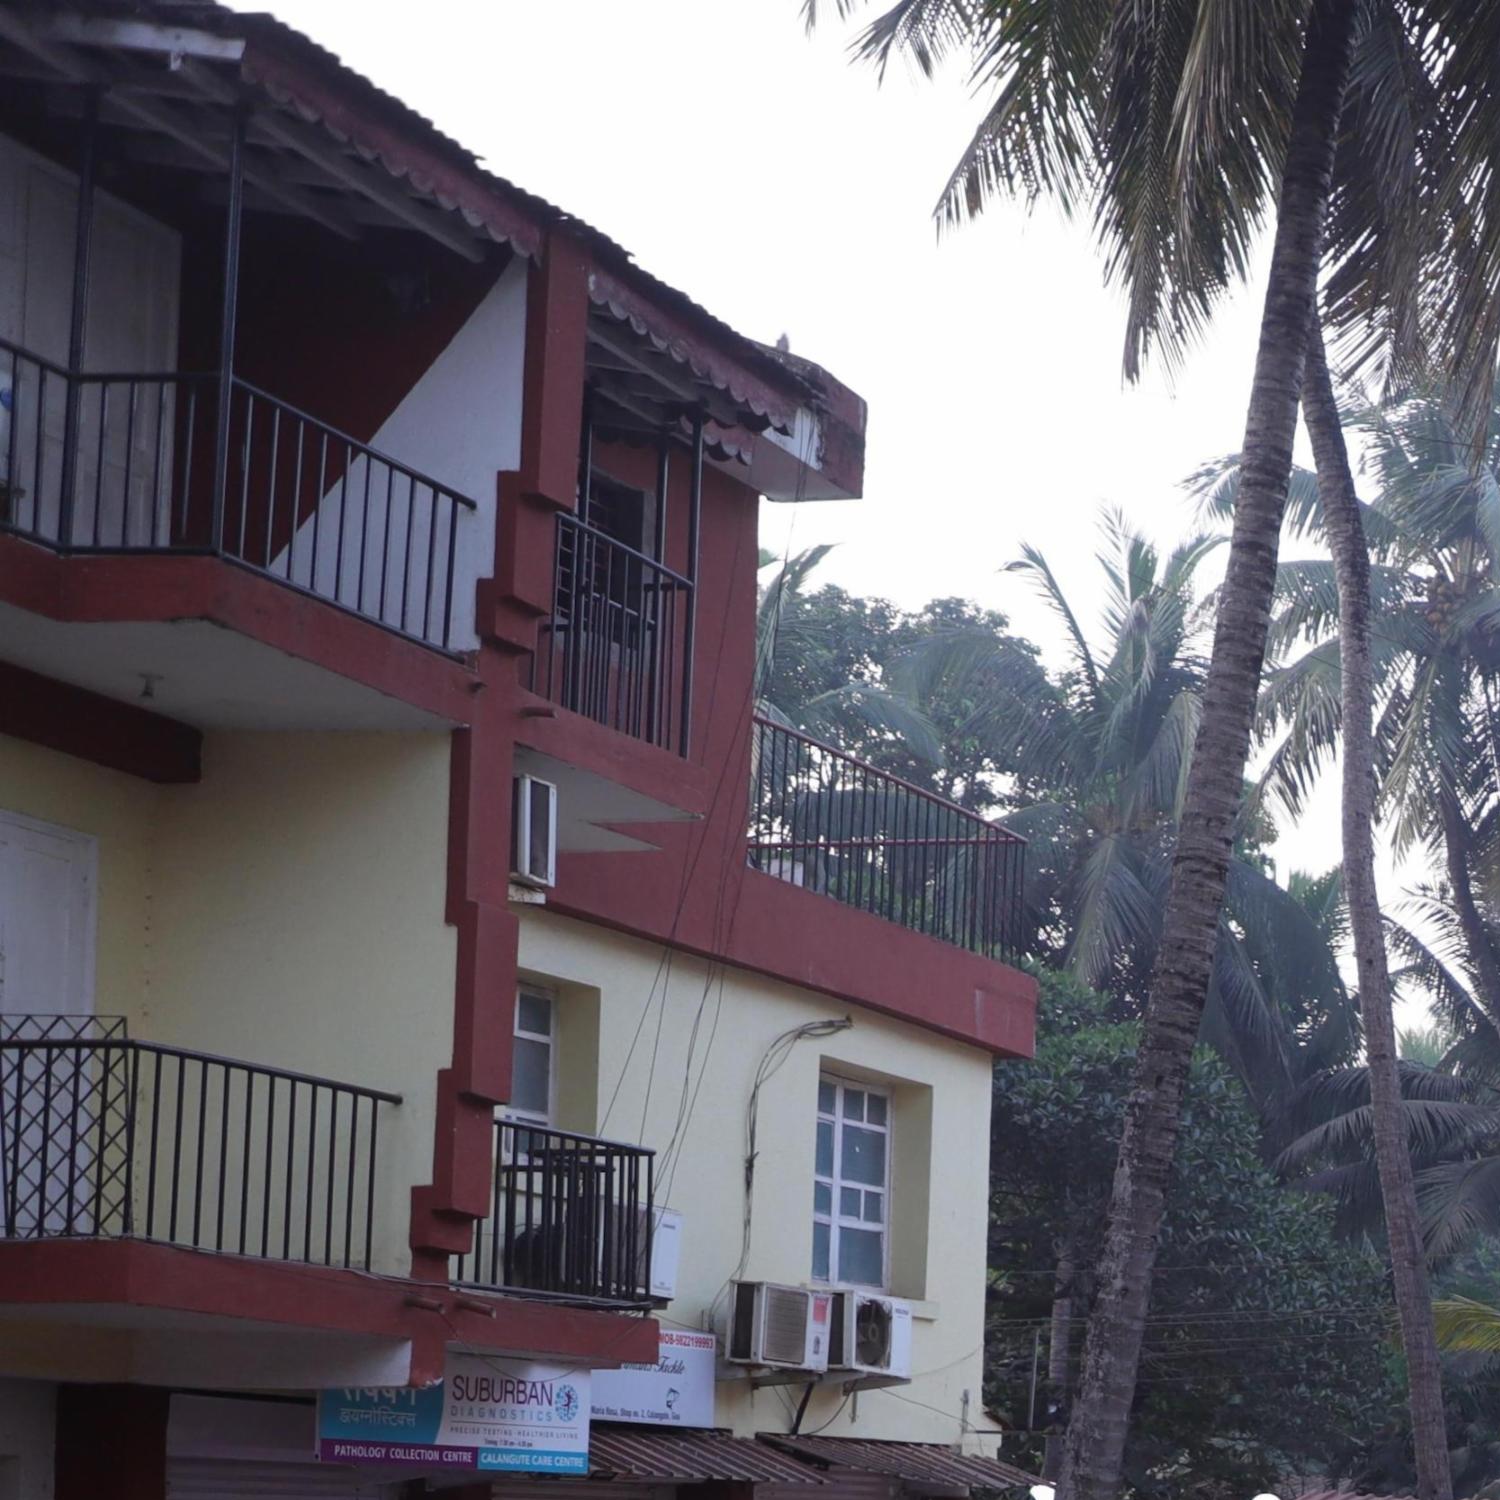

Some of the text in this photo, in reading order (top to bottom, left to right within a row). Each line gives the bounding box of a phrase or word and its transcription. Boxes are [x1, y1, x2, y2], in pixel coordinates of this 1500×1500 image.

[452, 1375, 553, 1407] SUBURBAN
[450, 1405, 553, 1421] DIAGNOSTICS
[335, 1445, 472, 1462] PATHOLOGY COLLECTION CENTRE
[481, 1453, 584, 1467] CALANGUTE CARE CENTRE
